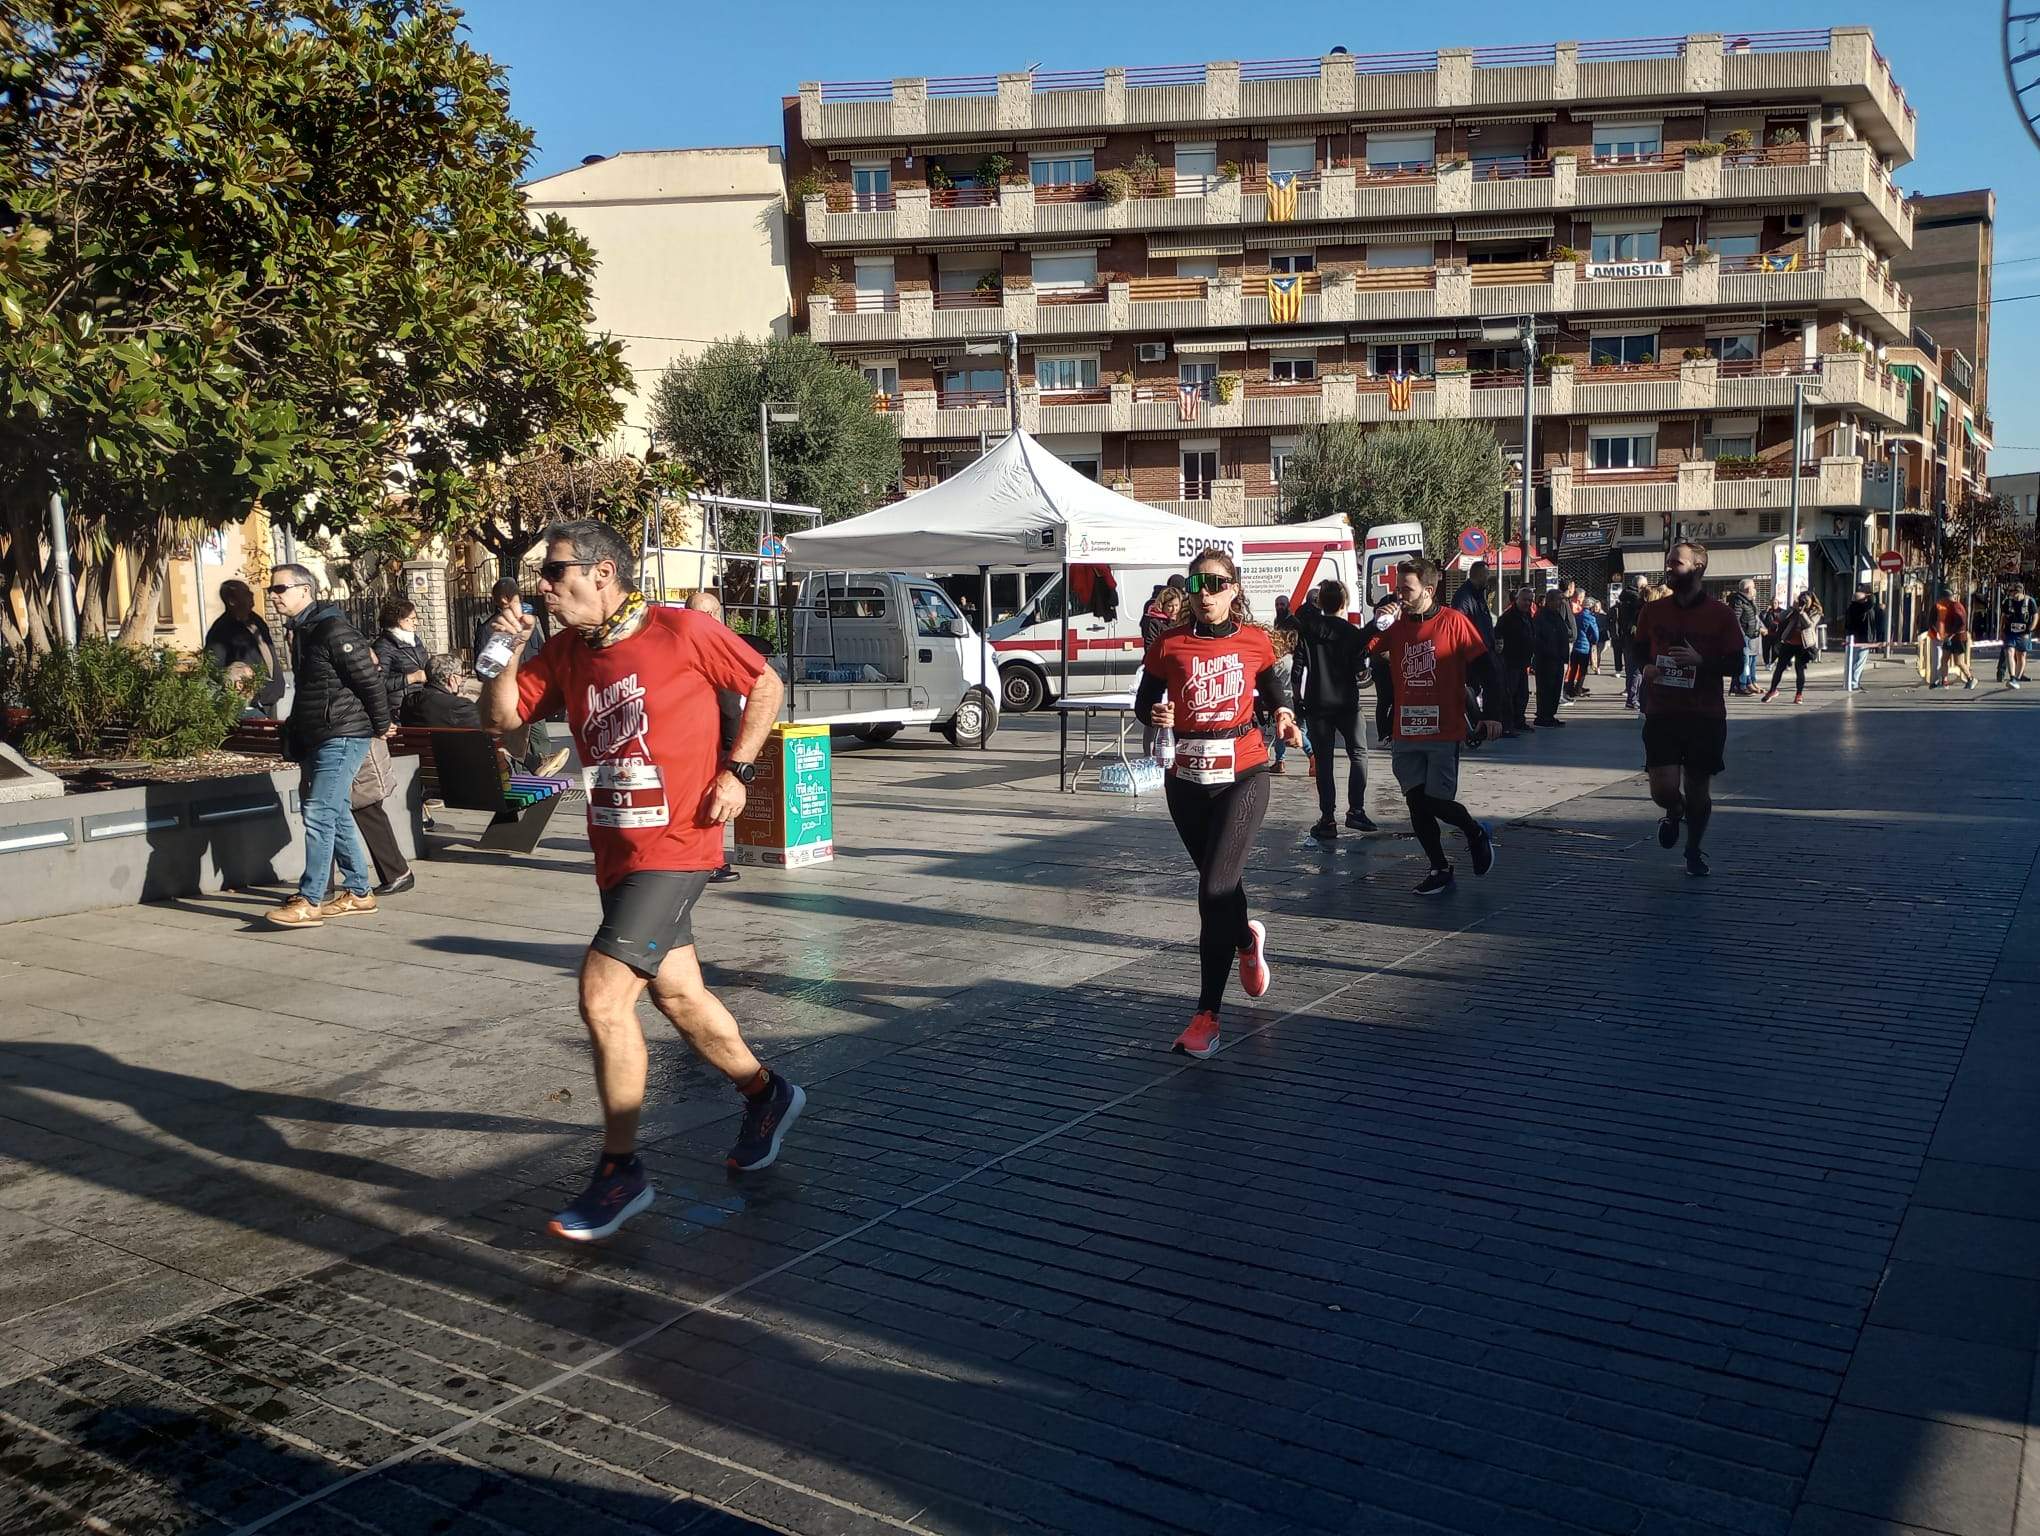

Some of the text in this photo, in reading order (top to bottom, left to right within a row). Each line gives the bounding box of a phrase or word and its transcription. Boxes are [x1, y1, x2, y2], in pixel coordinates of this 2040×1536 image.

[1593, 264, 1664, 277] AMNISTIA
[1566, 530, 1602, 539] INFOTEL
[1178, 536, 1234, 558] ESPORTS
[1206, 653, 1240, 676] cursa
[1664, 667, 1684, 677] 299
[602, 673, 640, 709] cursa
[1223, 670, 1245, 697] UAB
[1410, 717, 1428, 726] 259
[1189, 757, 1217, 769] 287
[611, 790, 633, 807] 91
